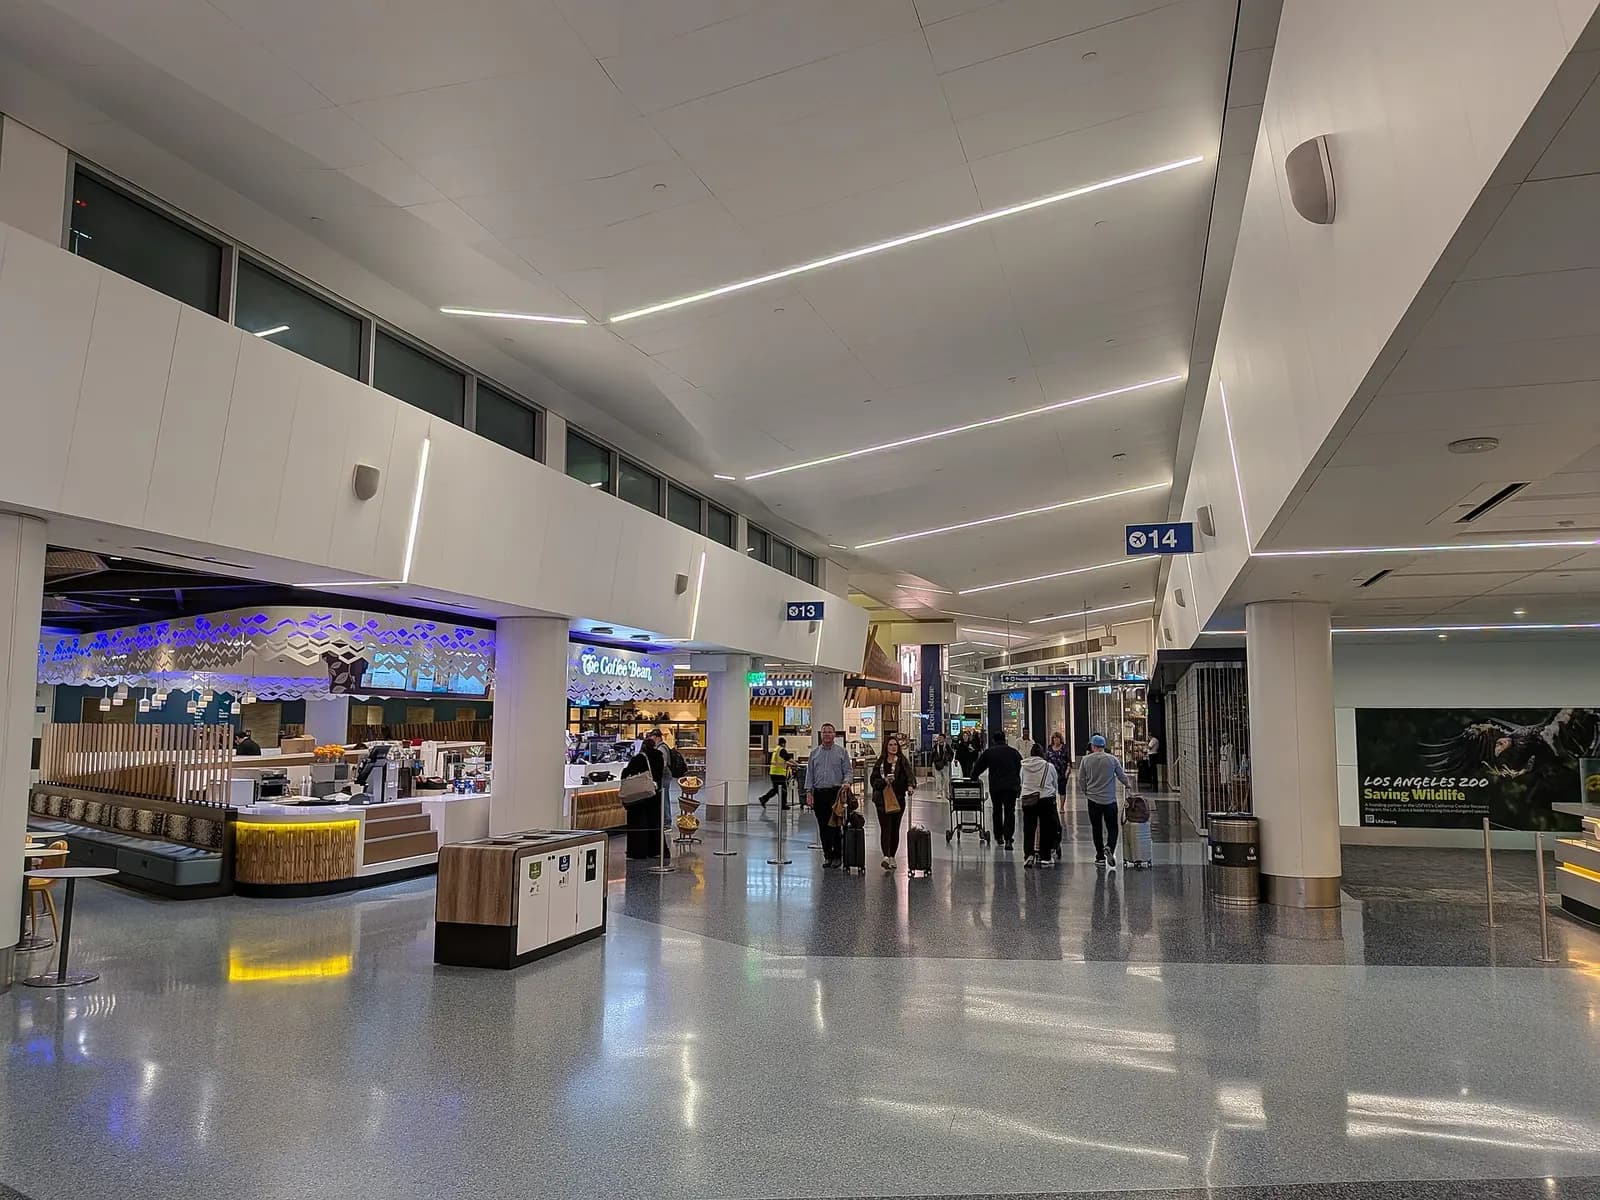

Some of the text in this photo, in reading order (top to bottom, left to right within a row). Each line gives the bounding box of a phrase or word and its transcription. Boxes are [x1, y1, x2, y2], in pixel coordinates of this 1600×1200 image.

[1148, 528, 1178, 549] 14
[799, 605, 816, 617] 13
[581, 654, 652, 681] The Coffee Bean
[926, 685, 935, 731] Brookstone
[1363, 776, 1489, 789] LOS ANGELES ZOO
[1363, 788, 1466, 803] Saving Wildlife
